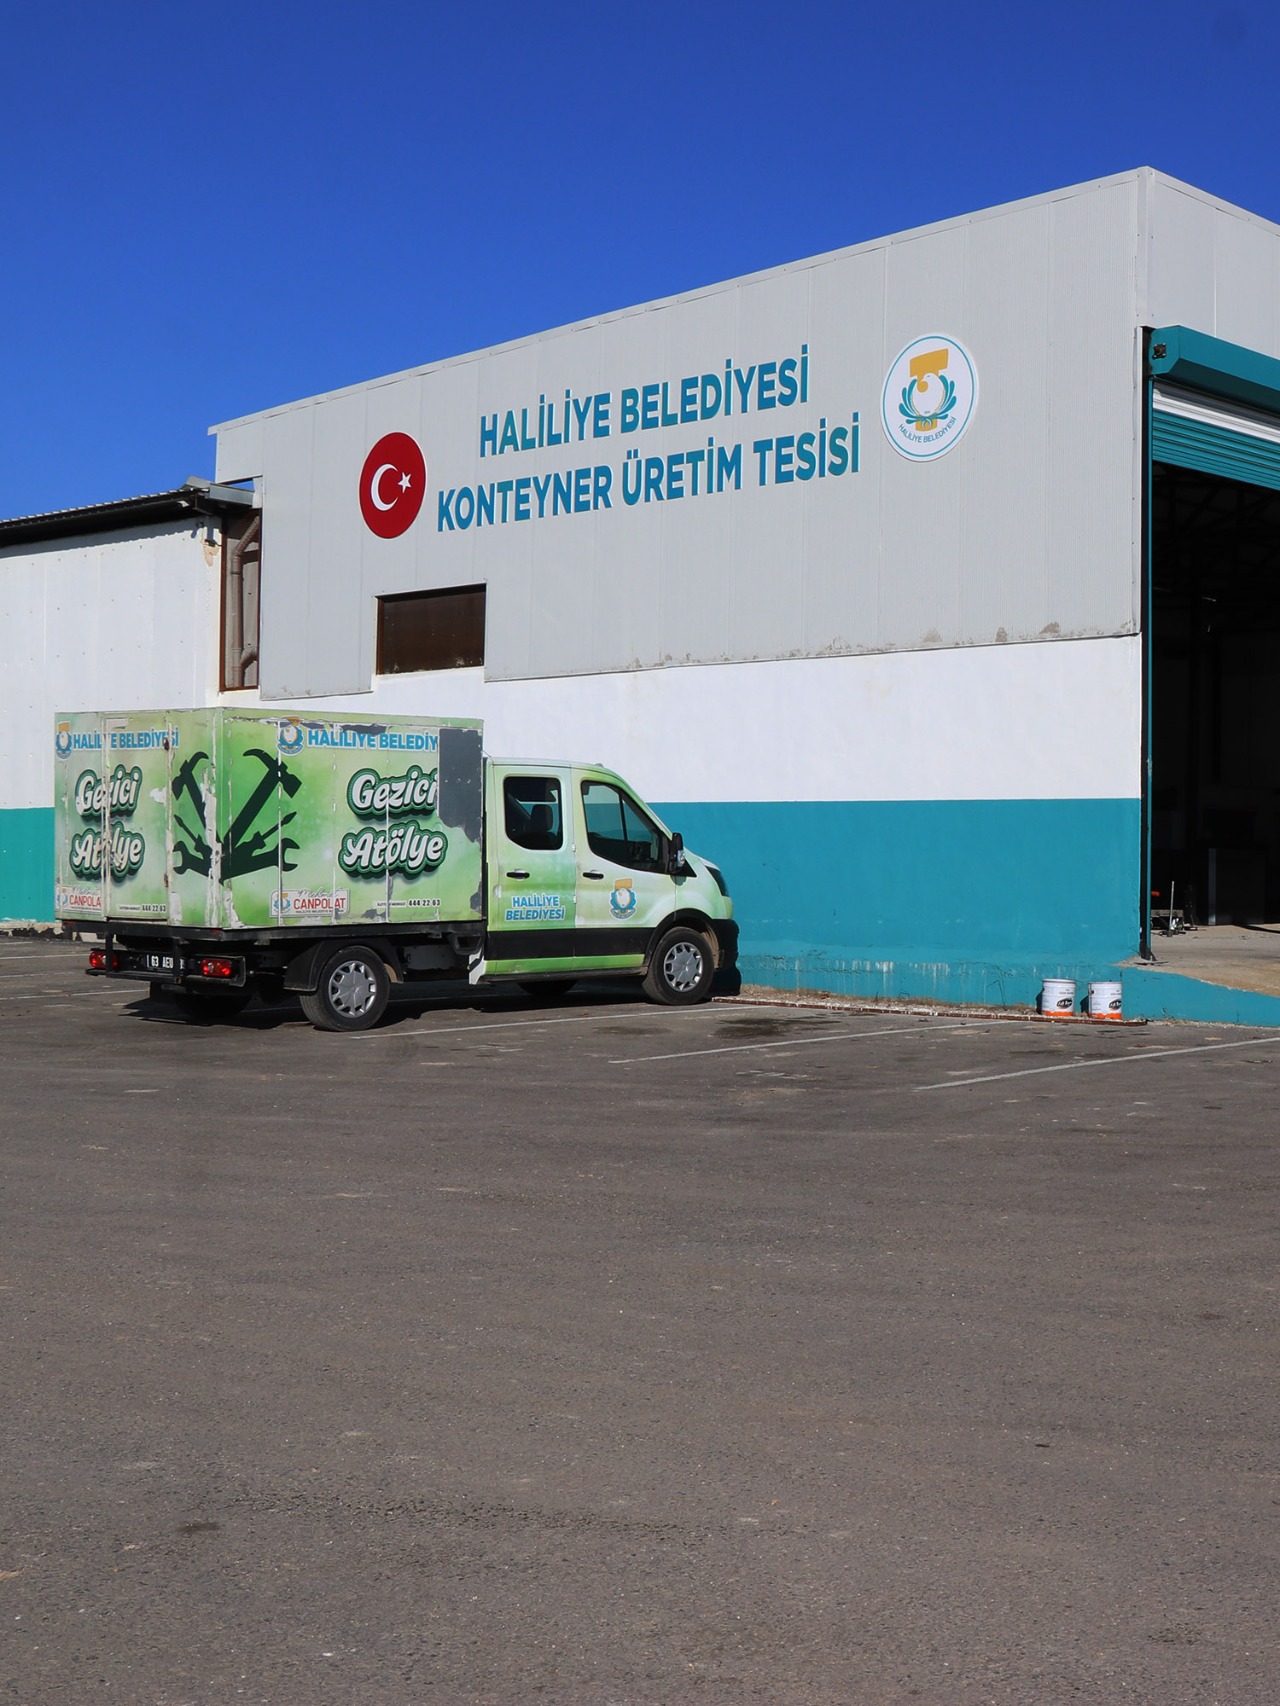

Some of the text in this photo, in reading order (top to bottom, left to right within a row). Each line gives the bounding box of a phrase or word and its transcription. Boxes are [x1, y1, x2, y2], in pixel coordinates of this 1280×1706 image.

[480, 343, 809, 458] HALİLİYE BELEDİYESİ
[437, 411, 860, 533] KONTEYNER ÜRETİM TESİSİ
[73, 729, 118, 749] HALİLE
[77, 769, 139, 811] Geici
[72, 826, 142, 871] Atlye
[342, 825, 444, 869] Atölye
[293, 898, 346, 910] CANPOLAT
[505, 906, 565, 920] BELEDİYESİ
[512, 894, 559, 907] HALİLİYE
